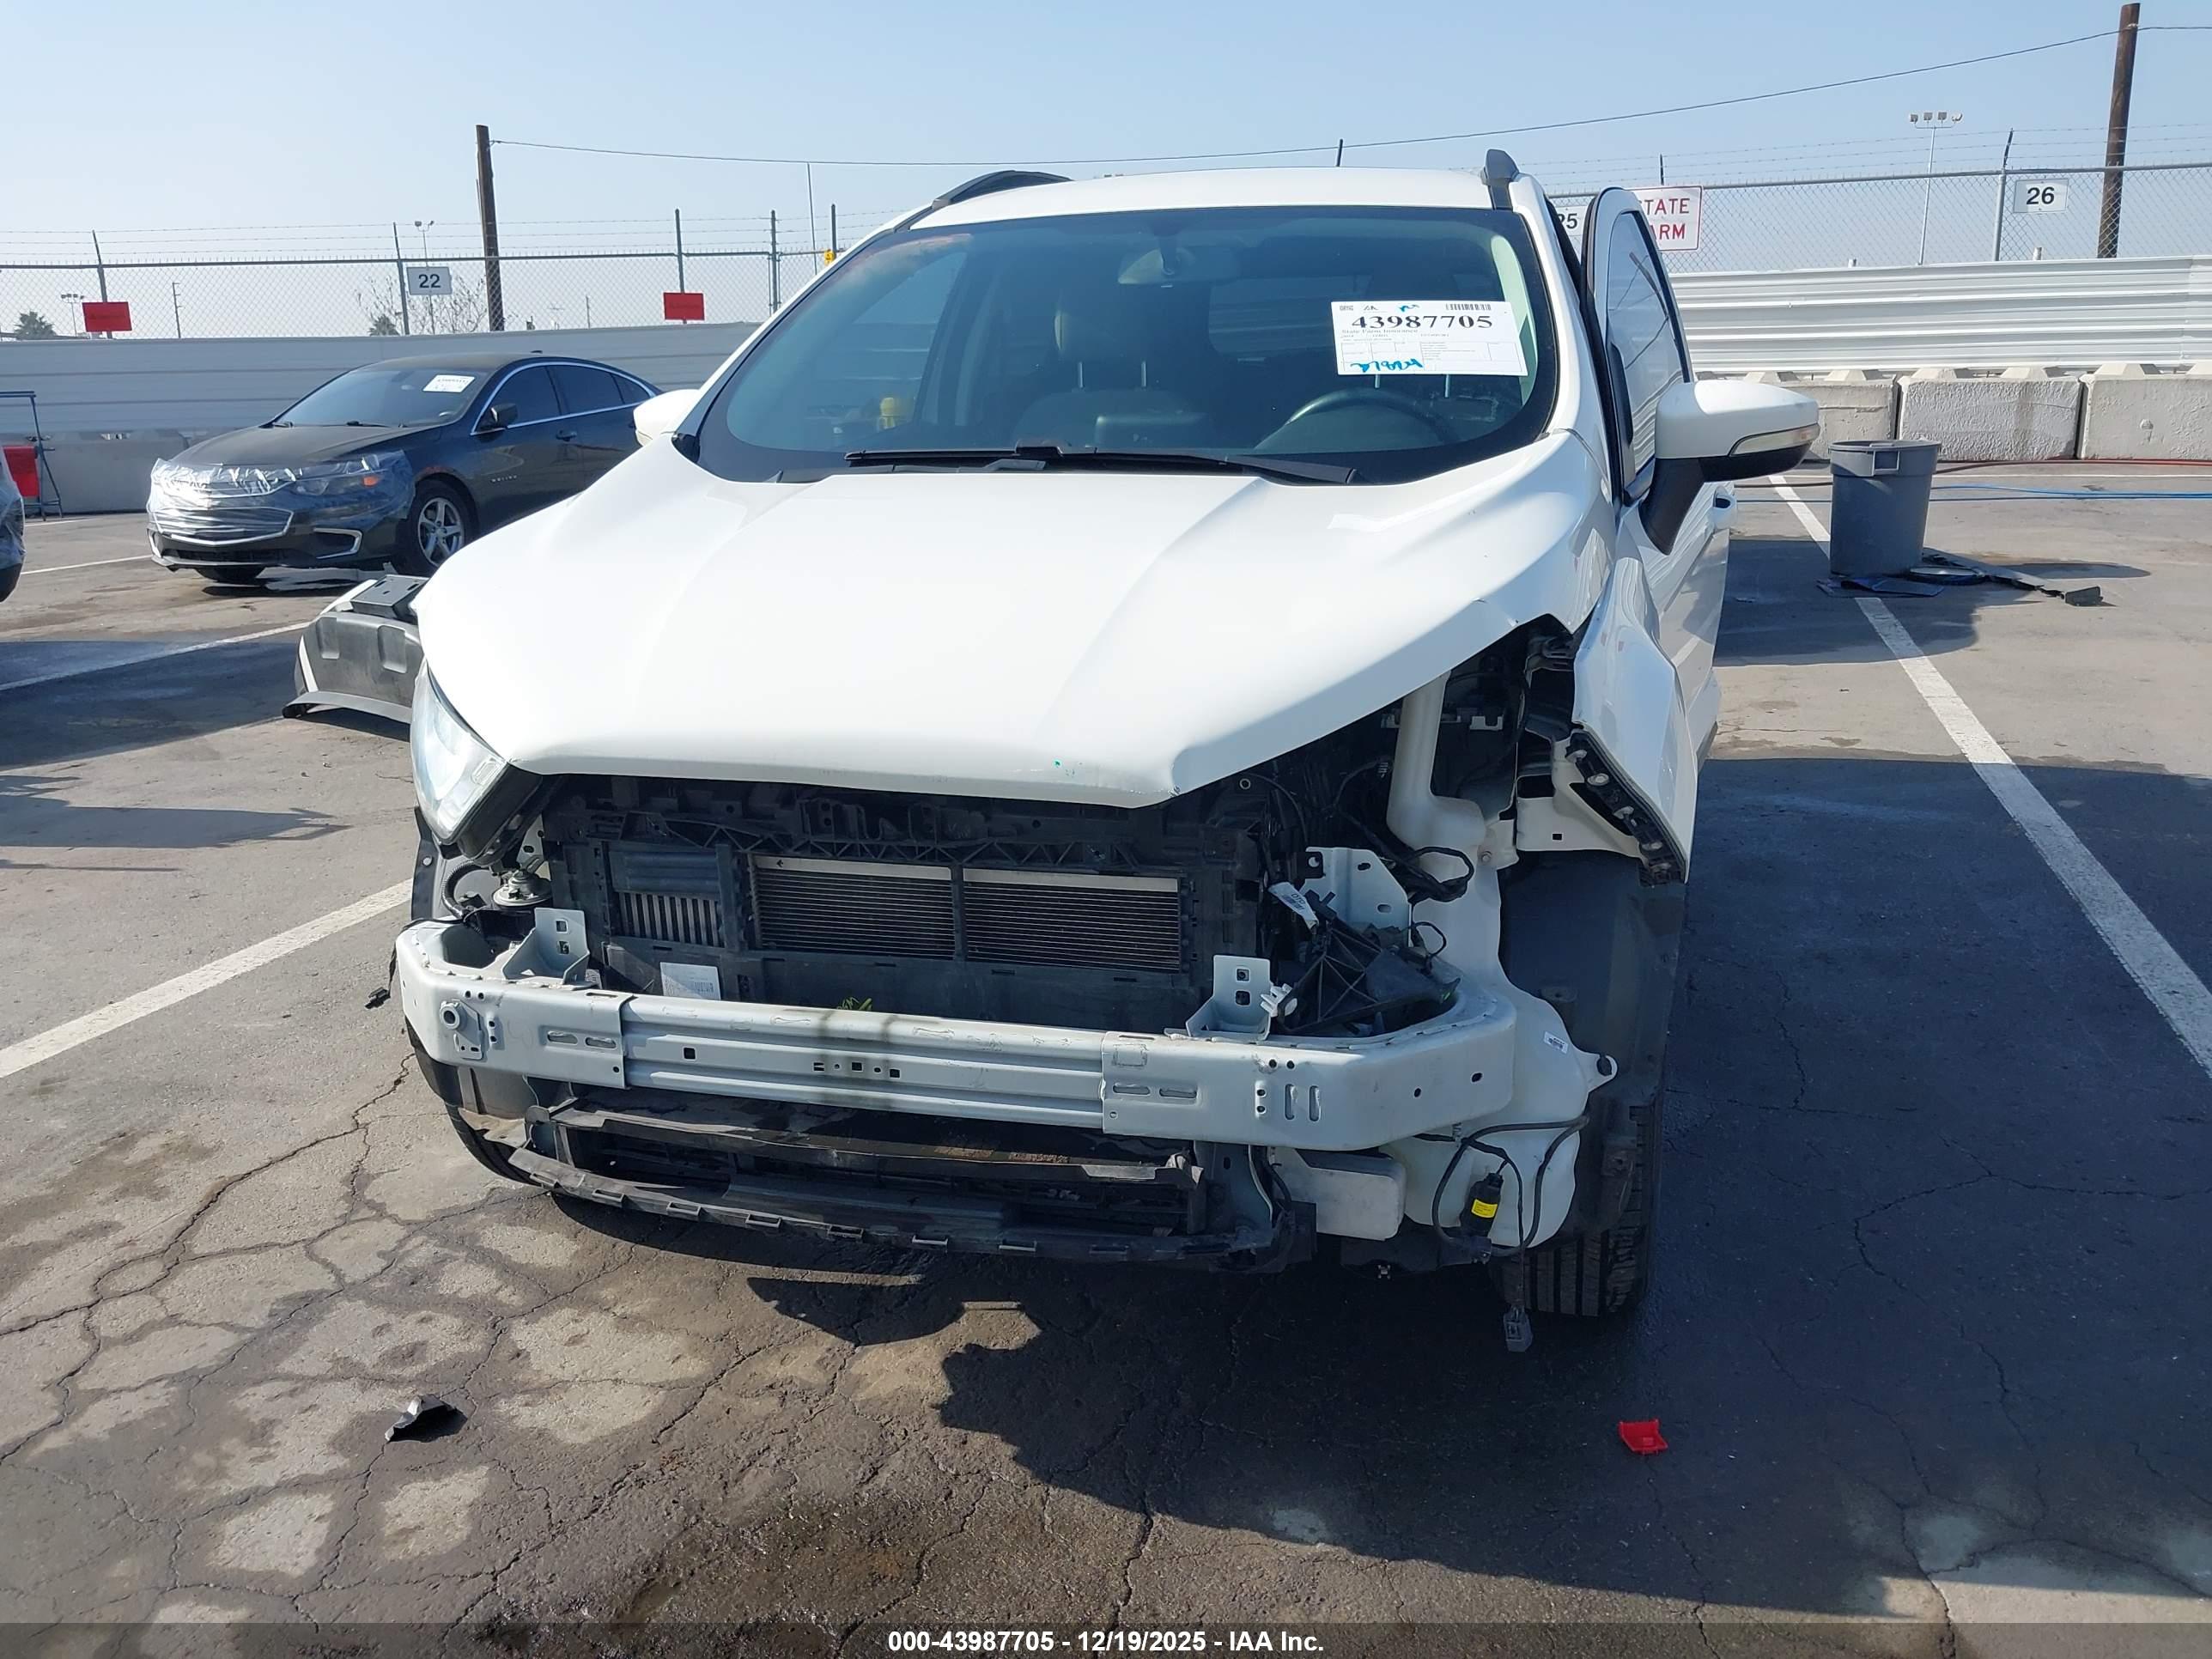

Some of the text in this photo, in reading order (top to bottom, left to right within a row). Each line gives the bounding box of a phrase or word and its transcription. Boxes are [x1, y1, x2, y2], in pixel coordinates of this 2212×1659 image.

[2027, 186, 2055, 204] 26
[1639, 198, 1690, 215] TATE
[418, 273, 441, 289] 22
[1352, 315, 1493, 329] 43987705
